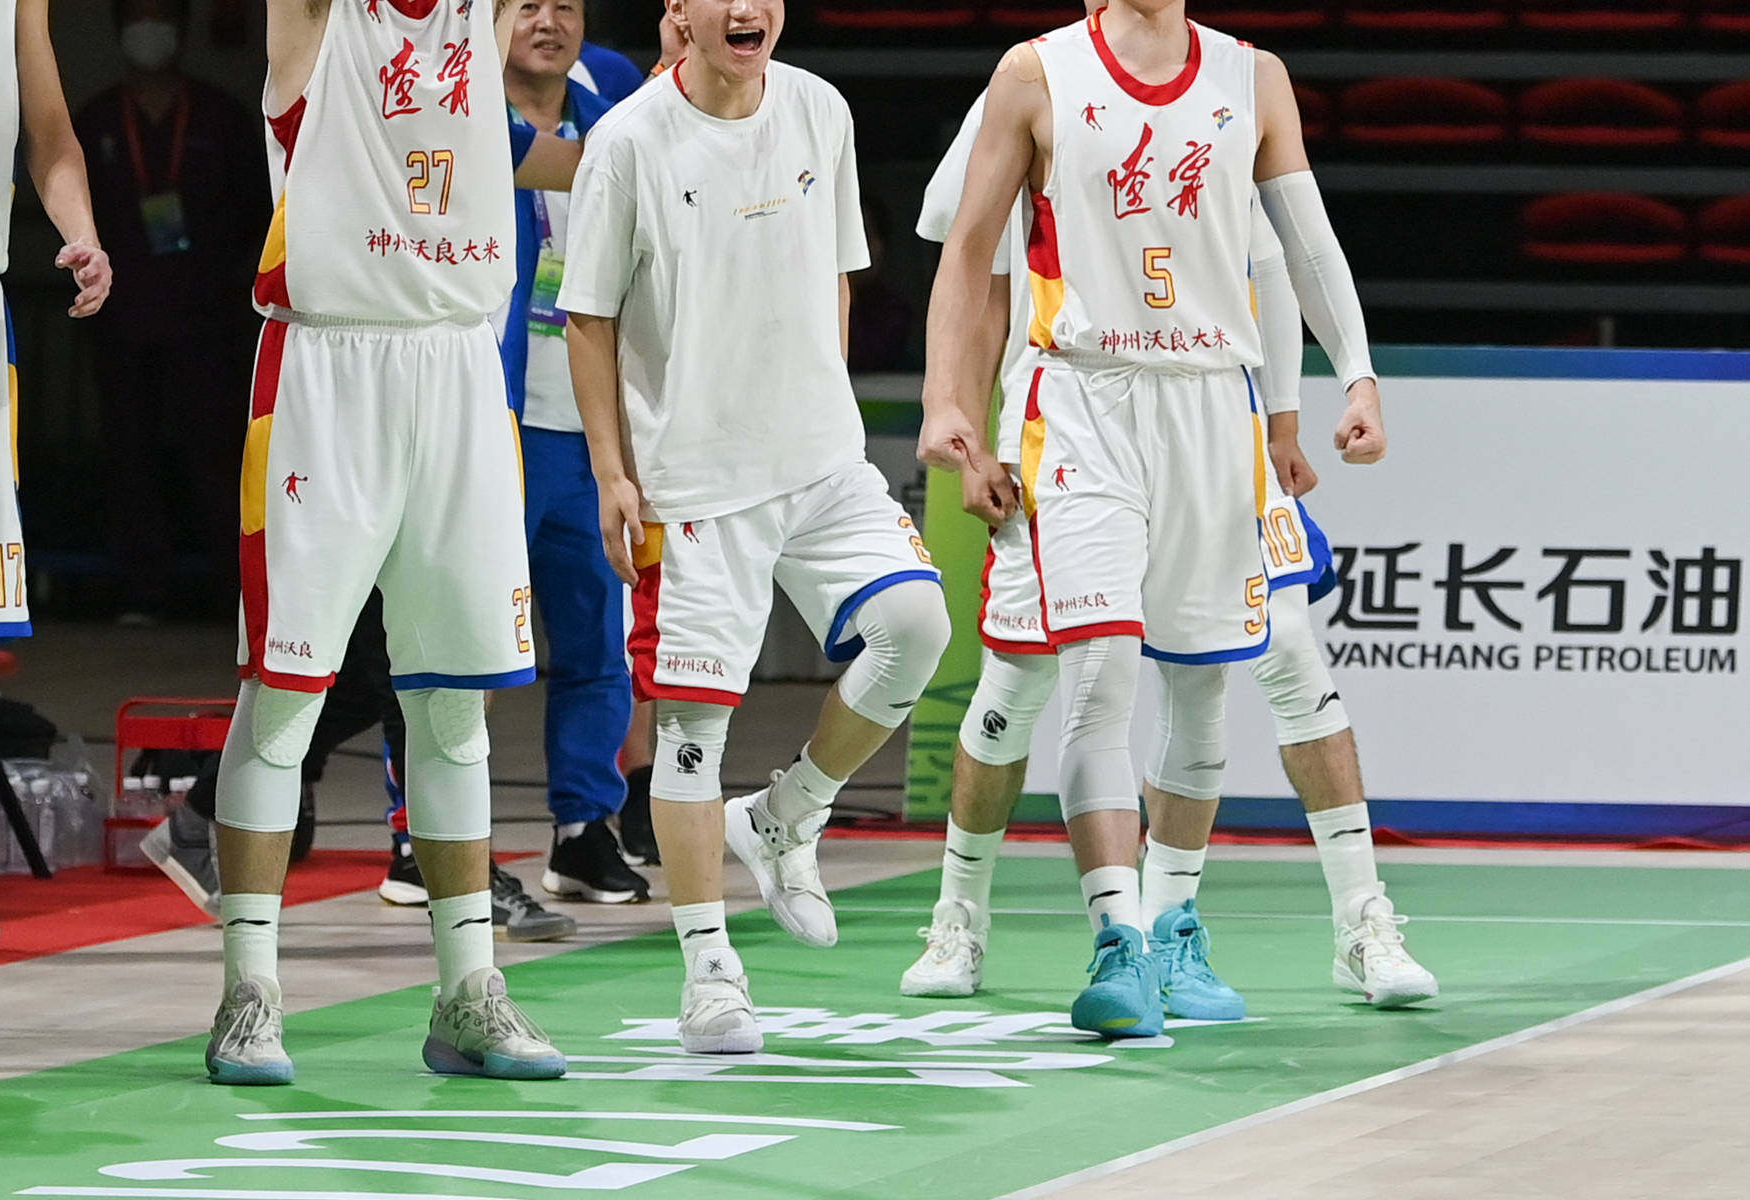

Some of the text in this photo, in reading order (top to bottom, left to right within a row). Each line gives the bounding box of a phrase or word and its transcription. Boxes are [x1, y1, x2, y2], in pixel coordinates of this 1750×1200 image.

[406, 150, 454, 215] 27
[1143, 247, 1176, 309] 5
[1100, 326, 1231, 353] 神州沃良大米
[1262, 507, 1304, 568] 10
[1245, 573, 1265, 636] 5
[1327, 542, 1741, 635] 延长石油
[1326, 642, 1738, 675] YANCHANG PETROLEUM
